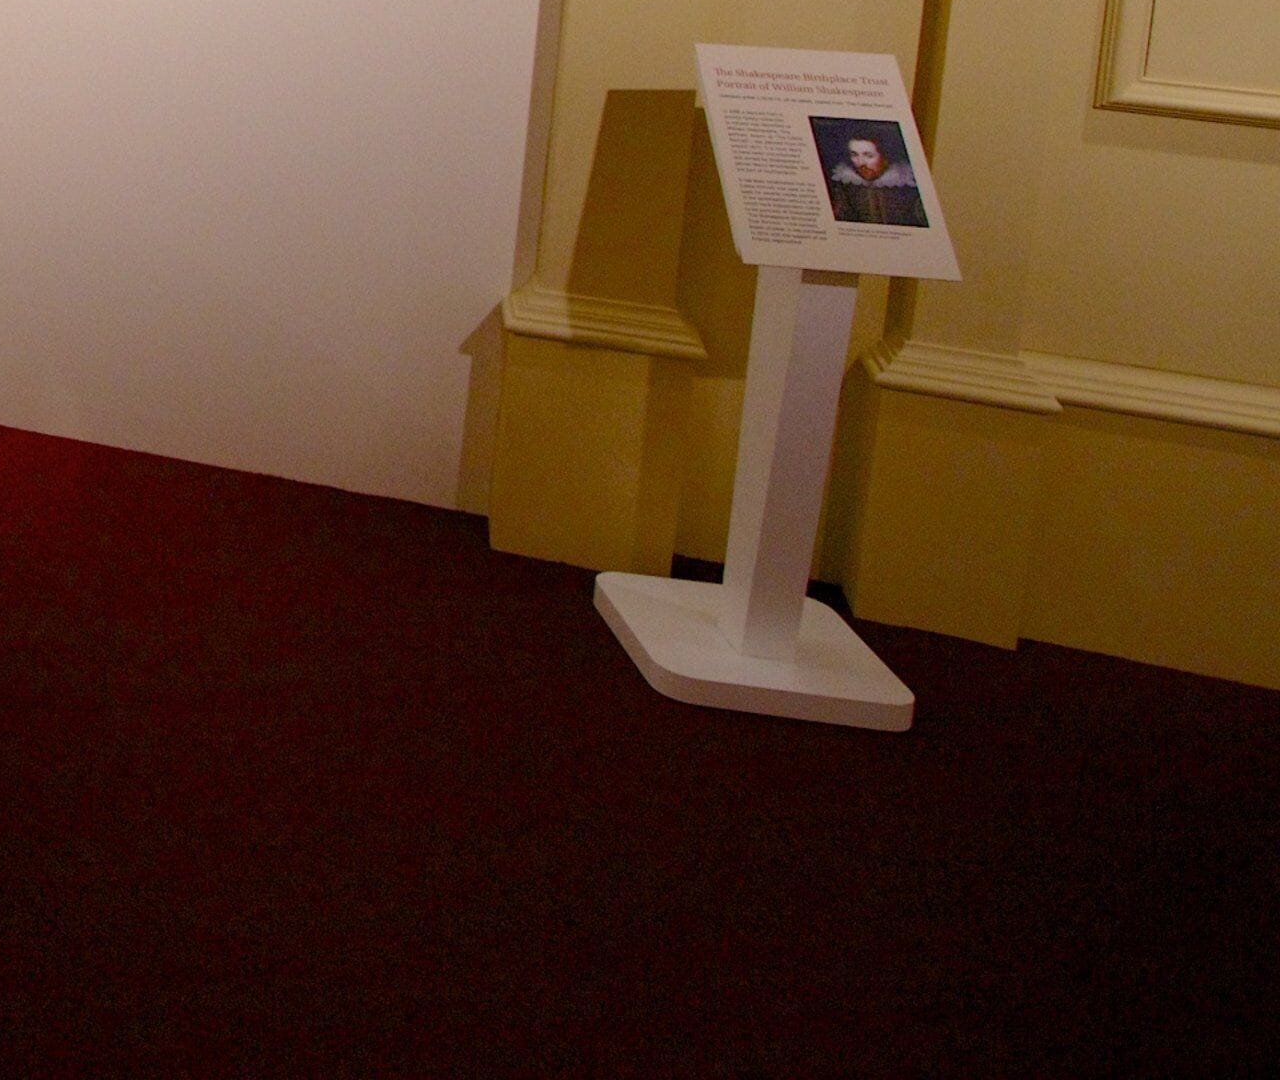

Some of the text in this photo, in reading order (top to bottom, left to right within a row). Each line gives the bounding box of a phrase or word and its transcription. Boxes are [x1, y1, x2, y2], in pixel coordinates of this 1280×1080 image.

[715, 68, 887, 85] The Shakespeare Birthplace Trust
[717, 80, 756, 89] Portrait
[772, 84, 813, 92] William
[816, 86, 882, 97] Shakespeare
